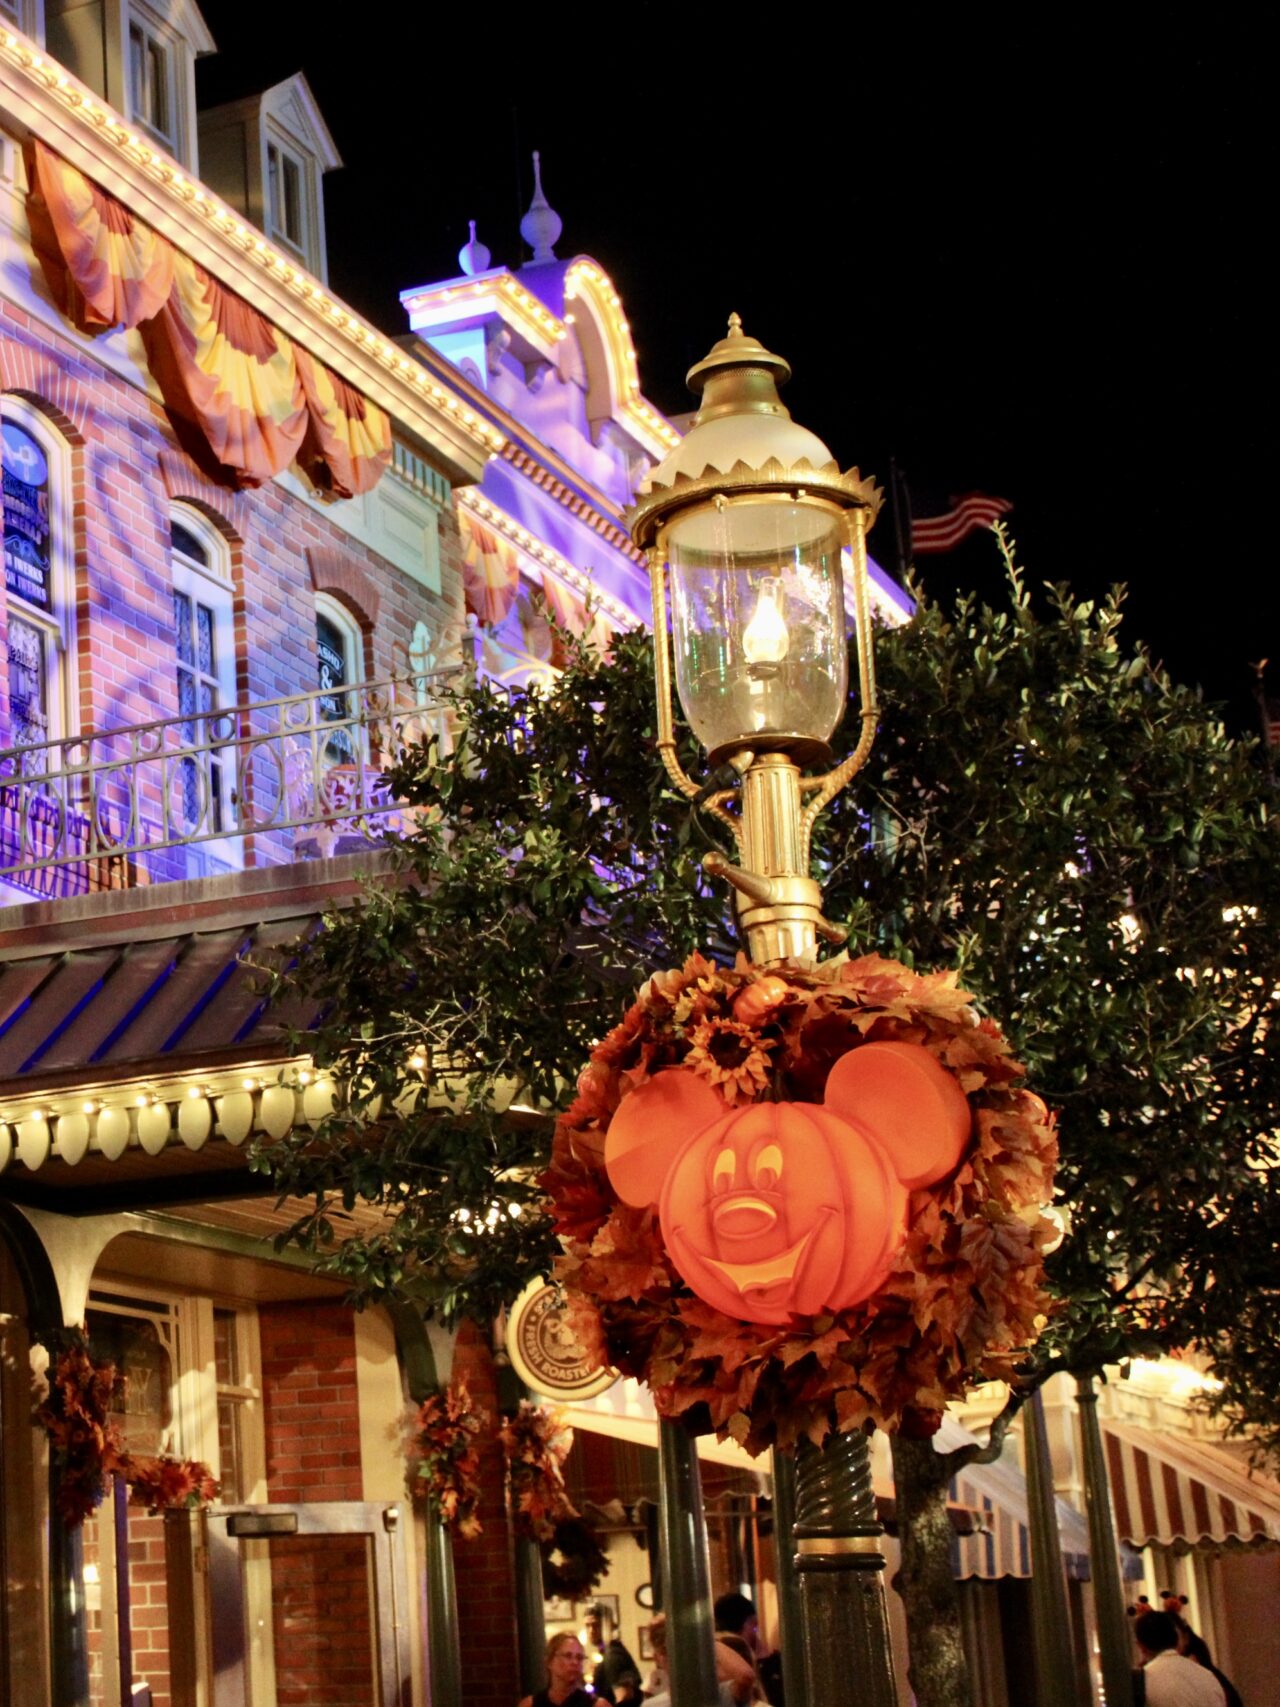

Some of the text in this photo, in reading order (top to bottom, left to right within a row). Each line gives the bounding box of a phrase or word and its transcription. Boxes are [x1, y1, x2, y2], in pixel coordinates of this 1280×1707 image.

[14, 556, 44, 585] IWERKS
[321, 665, 333, 690] &
[525, 1325, 590, 1381] FRESH ROASTE
